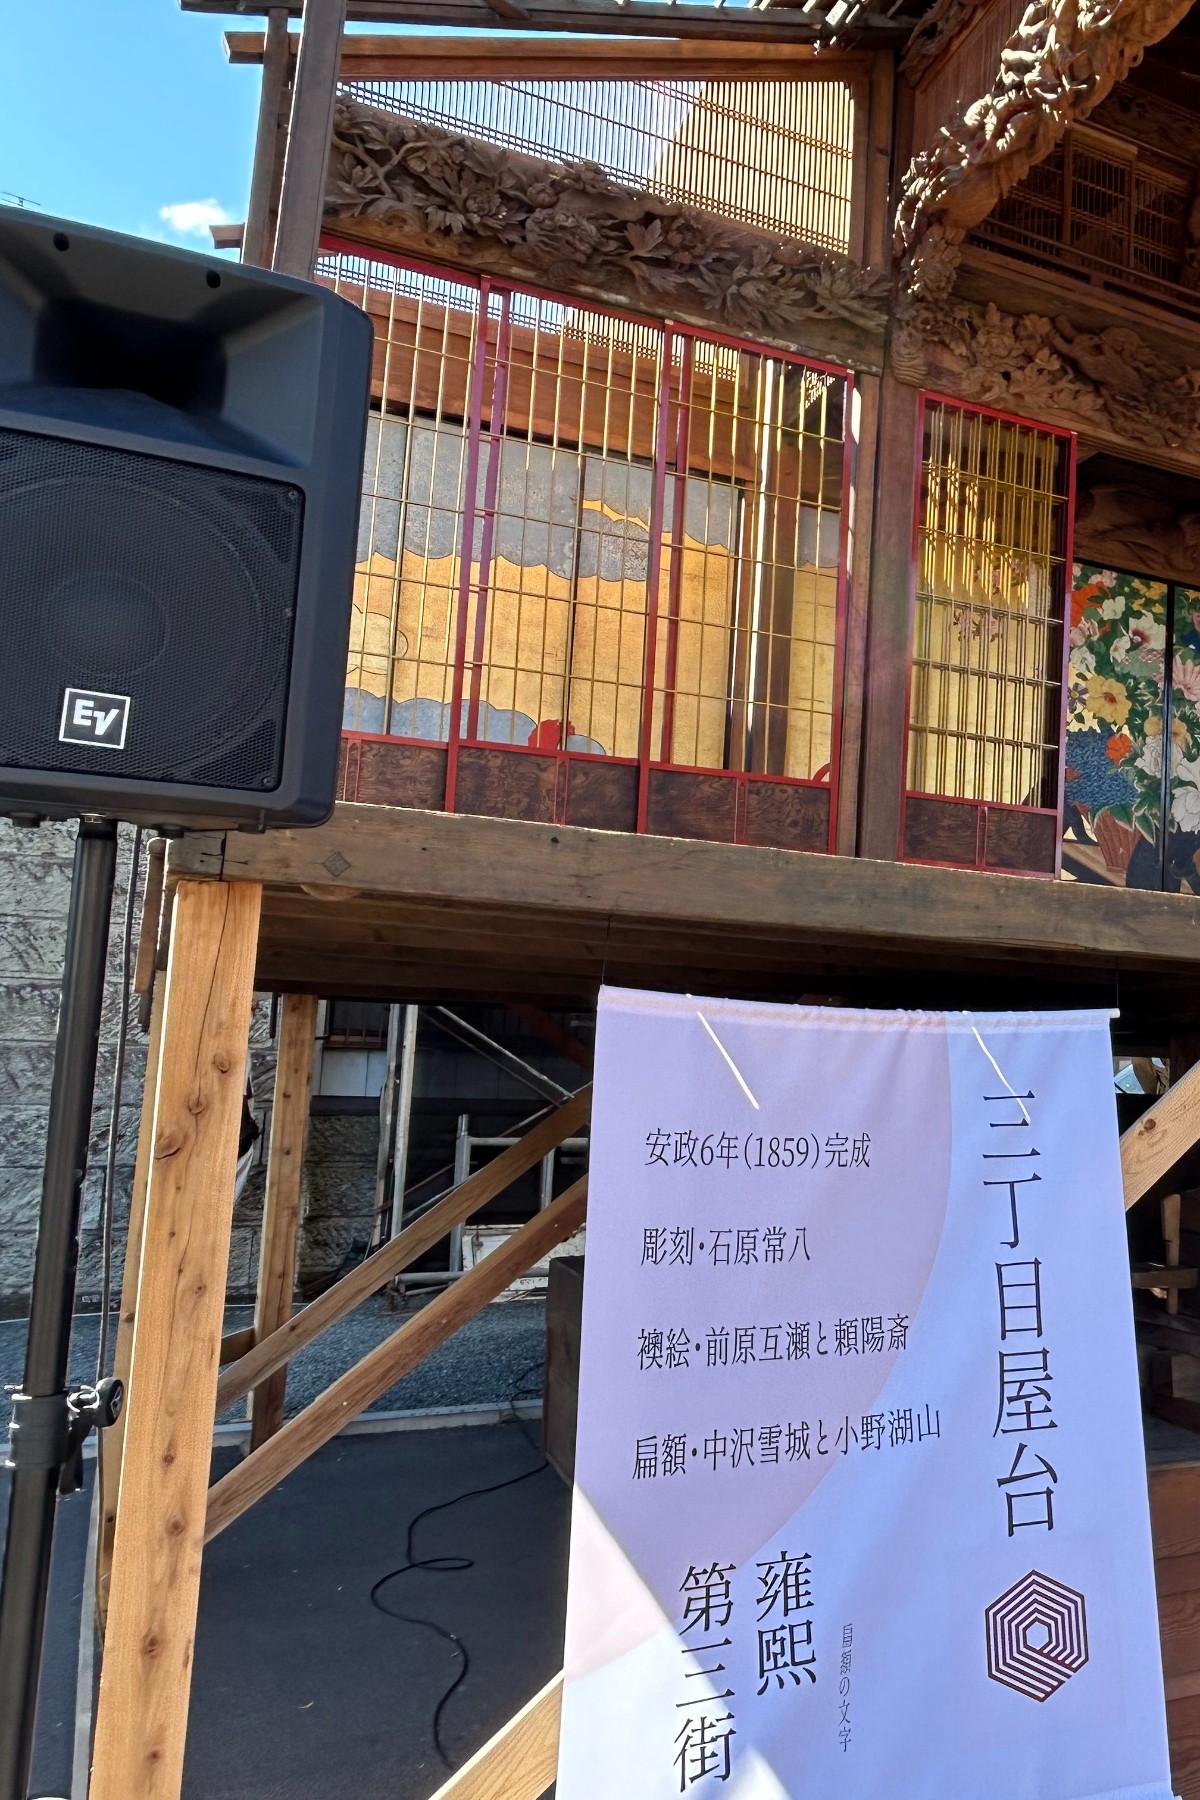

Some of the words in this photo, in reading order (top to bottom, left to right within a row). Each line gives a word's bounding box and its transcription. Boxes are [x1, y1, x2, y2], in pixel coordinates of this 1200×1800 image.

[73, 699, 119, 735] EV
[645, 1128, 871, 1169] 安政6年(1859)完成
[641, 1226, 811, 1266] 彫刻・石原常八
[982, 1089, 1058, 1538] 三丁目屋台
[673, 1562, 737, 1793] 第三街
